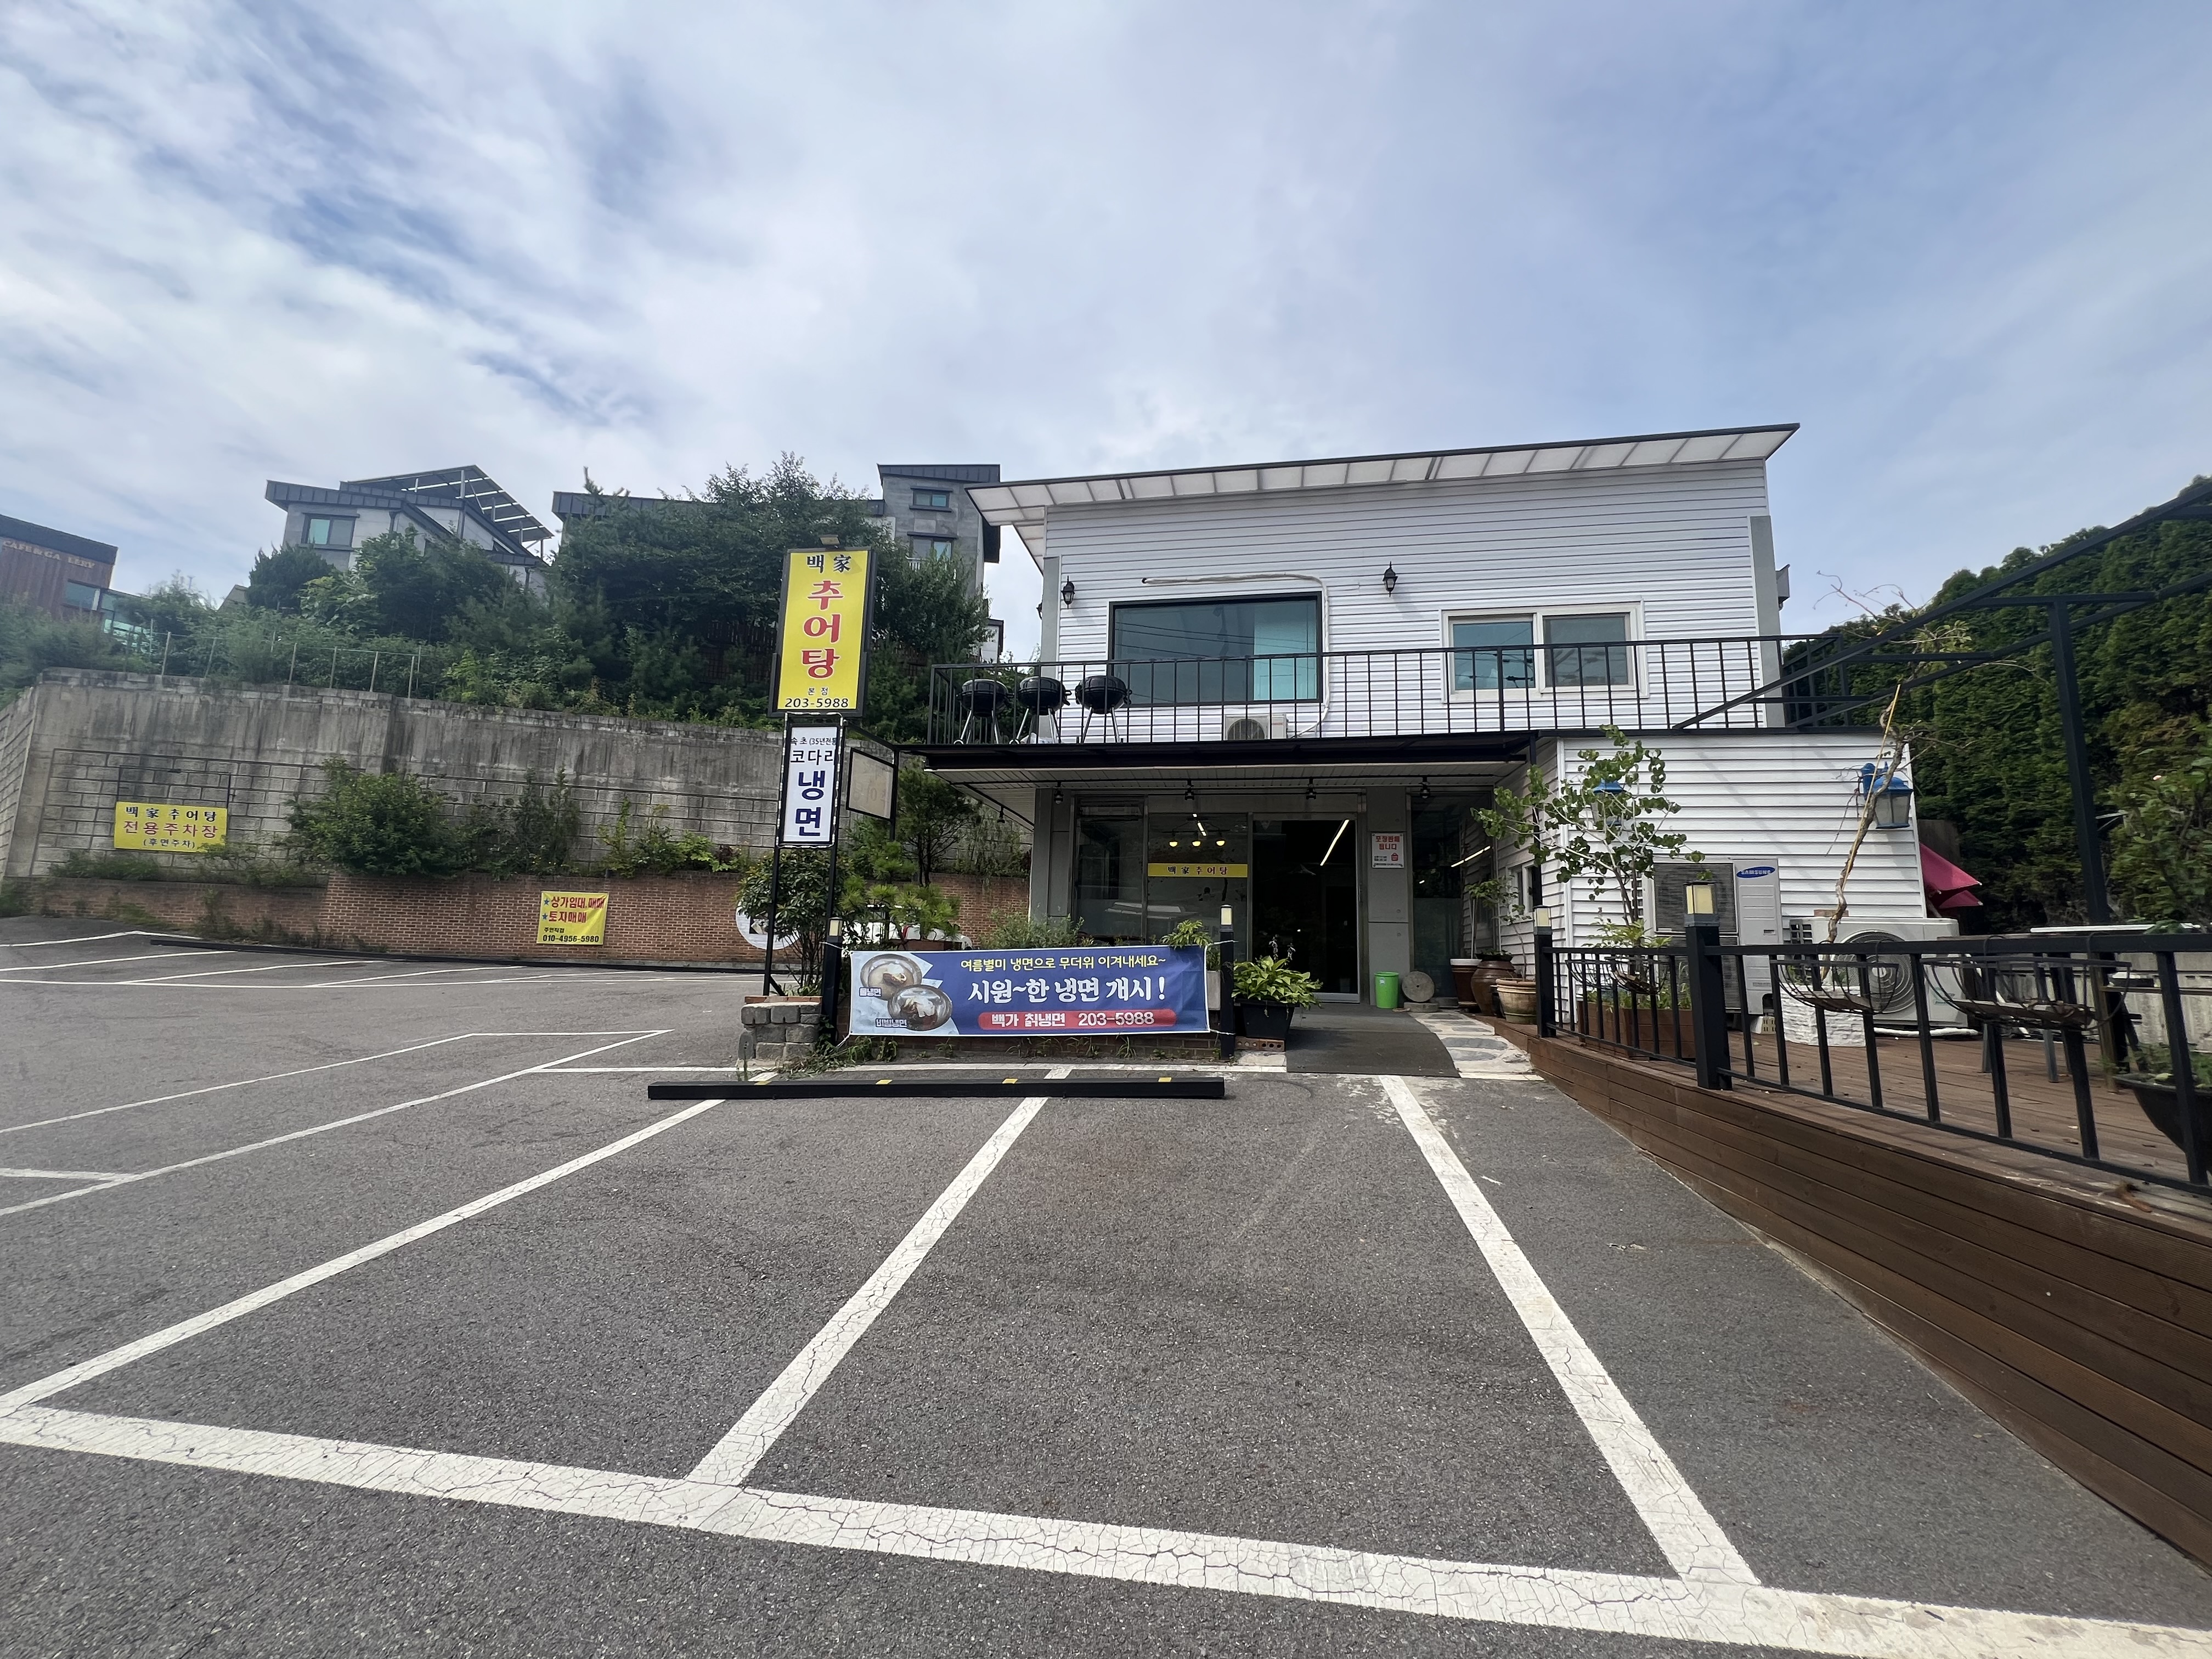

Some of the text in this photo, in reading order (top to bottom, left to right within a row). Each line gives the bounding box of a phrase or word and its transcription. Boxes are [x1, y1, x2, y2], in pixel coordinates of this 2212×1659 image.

[802, 580, 844, 679] 추어탕
[785, 698, 849, 708] 203-5988
[795, 770, 826, 837] 냉면
[123, 821, 218, 838] 전용주차장
[143, 838, 195, 849] (후면주차)
[1195, 866, 1228, 875] 추어탕
[549, 911, 587, 923] 토지매매
[543, 934, 599, 943] 010-4956-5980
[961, 955, 1166, 972] 여름별미 냉면으로 무더위 이겨내세요~
[860, 988, 882, 997] 냉면
[967, 978, 1050, 1004] 시원~한
[1054, 977, 1100, 1002] 냉면
[991, 1011, 1155, 1028] 백가 칡냉면 203-5988
